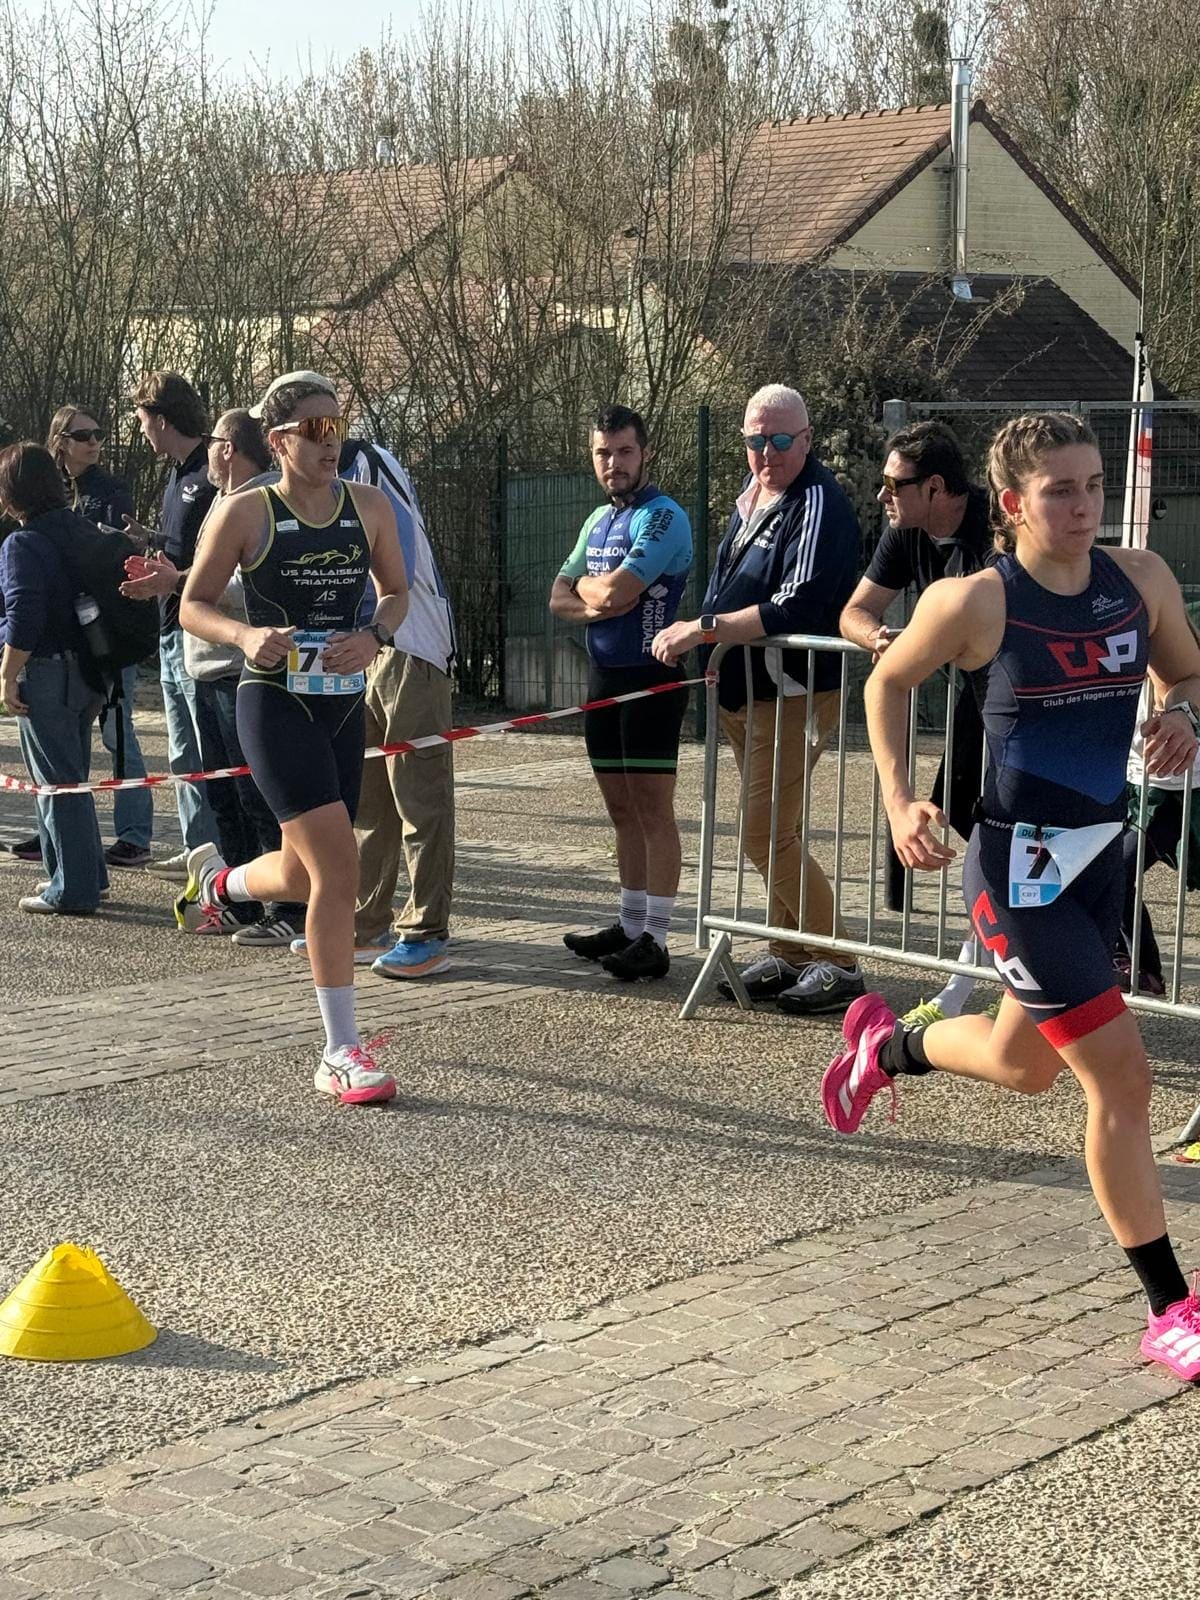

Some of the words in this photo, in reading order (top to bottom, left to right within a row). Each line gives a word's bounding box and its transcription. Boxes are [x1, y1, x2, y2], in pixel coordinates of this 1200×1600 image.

[658, 508, 675, 532] AG2R
[293, 577, 357, 586] TRIATHLON
[302, 567, 364, 576] PALAISEAU
[642, 600, 654, 654] MONDIALE
[298, 647, 328, 673] 7
[1042, 698, 1064, 708] Club
[1066, 695, 1081, 704] des
[1083, 690, 1115, 700] Nageurs
[1116, 689, 1127, 697] de
